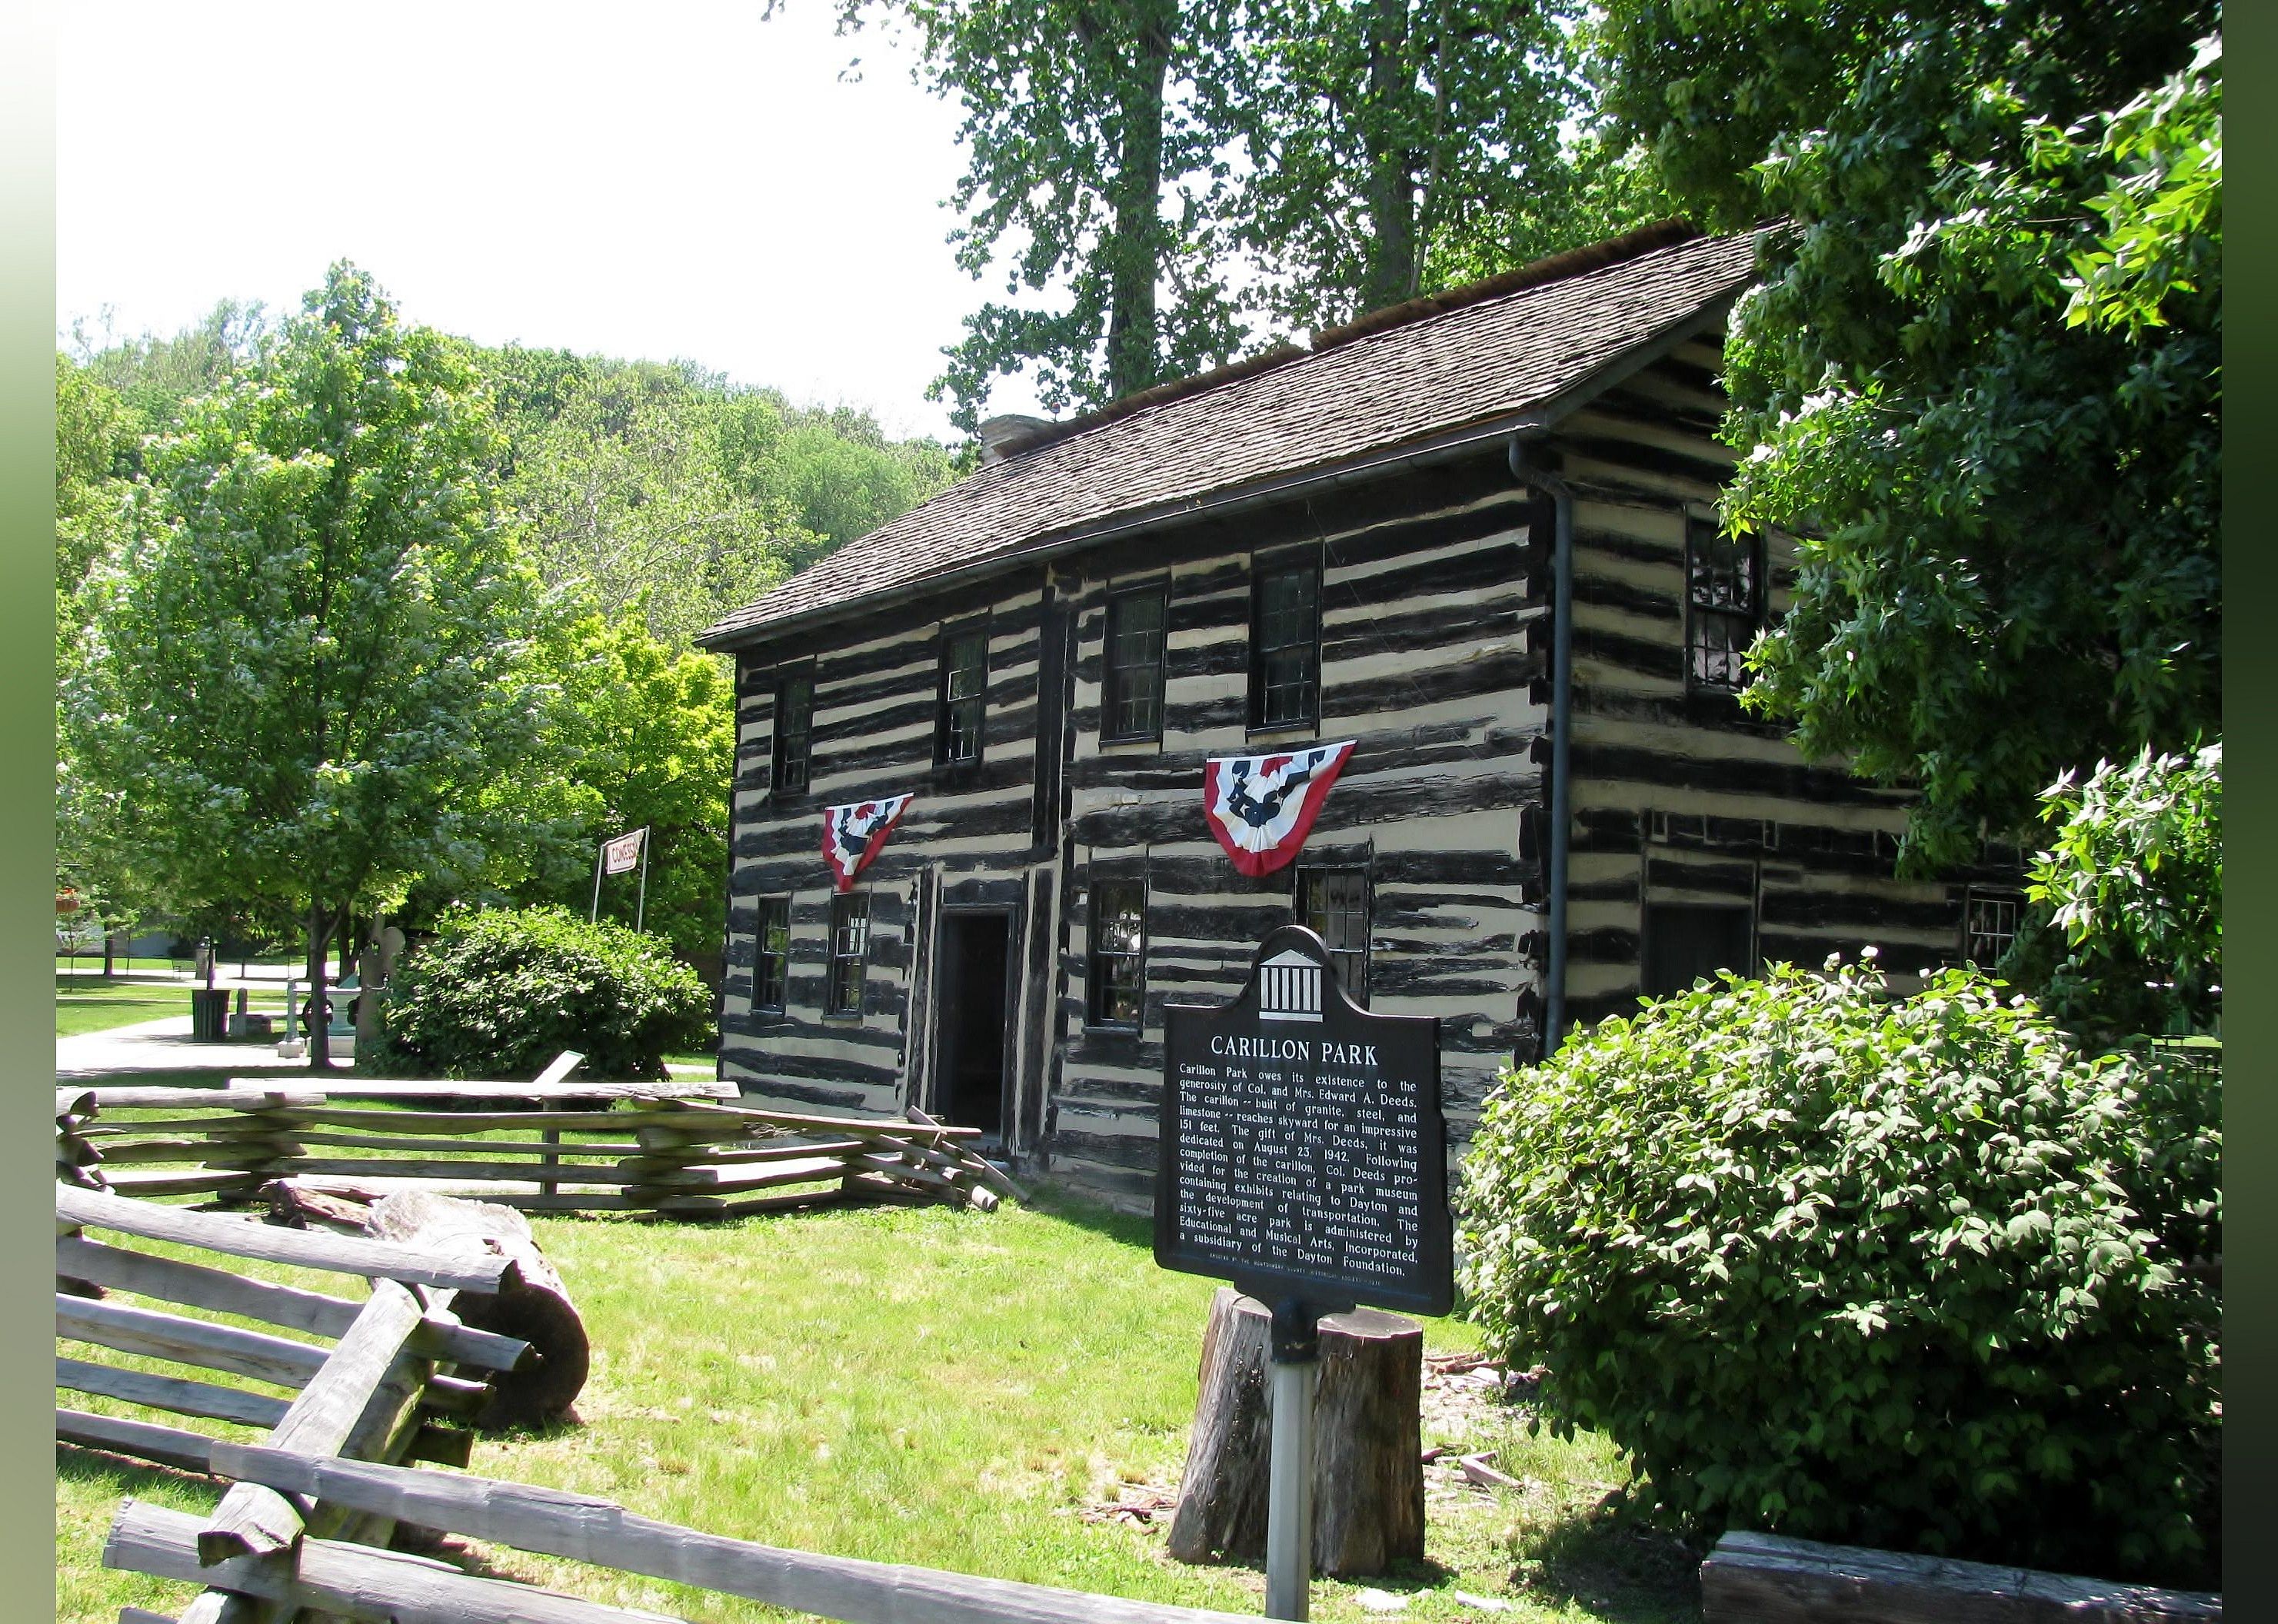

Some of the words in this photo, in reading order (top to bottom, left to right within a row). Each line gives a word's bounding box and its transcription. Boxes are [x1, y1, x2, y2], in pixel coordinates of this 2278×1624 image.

[1211, 1035, 1310, 1061] CARILLON
[1321, 1042, 1378, 1066] PARK
[1179, 1063, 1216, 1077] Carillon
[1226, 1066, 1248, 1079] Park
[1258, 1071, 1282, 1082] owes
[1292, 1071, 1304, 1083] its
[1315, 1073, 1365, 1088] existence
[1377, 1079, 1387, 1090] to
[1400, 1080, 1417, 1092] the
[1179, 1079, 1227, 1093] generosity
[1232, 1081, 1244, 1093] of
[1271, 1086, 1288, 1097] and
[1319, 1088, 1356, 1103] Edward
[1179, 1090, 1197, 1103] The
[1204, 1094, 1239, 1107] carillon
[1255, 1097, 1277, 1110] built
[1285, 1101, 1296, 1112] of
[1397, 1112, 1417, 1124] and
[1179, 1104, 1221, 1119] limestone
[1237, 1112, 1274, 1124] reaches
[1277, 1114, 1318, 1130] skyward
[1324, 1119, 1339, 1131] for
[1344, 1123, 1356, 1133] an
[1361, 1122, 1417, 1139] impressive
[1179, 1133, 1224, 1148] dedicated
[1232, 1141, 1244, 1150] on
[1254, 1141, 1288, 1156] August
[1366, 1153, 1417, 1173] Following
[1180, 1118, 1192, 1130] 151
[1231, 1123, 1250, 1136] The
[1257, 1127, 1276, 1141] gift
[1284, 1130, 1295, 1142] of
[1379, 1139, 1387, 1151] it
[1397, 1144, 1417, 1154] was
[1179, 1160, 1205, 1173] vided
[1212, 1164, 1226, 1176] for
[1234, 1168, 1249, 1179] the
[1256, 1172, 1297, 1186] creation
[1305, 1176, 1317, 1188] of
[1325, 1181, 1331, 1190] a
[1340, 1183, 1365, 1194] park
[1375, 1187, 1418, 1201] museum
[1180, 1148, 1228, 1163] completion
[1236, 1153, 1246, 1165] of
[1253, 1156, 1268, 1167] the
[1353, 1166, 1385, 1181] Deeds
[1394, 1174, 1418, 1186] pro-
[1179, 1176, 1227, 1194] containing
[1234, 1183, 1274, 1197] exhibits
[1282, 1189, 1321, 1206] relating
[1330, 1195, 1340, 1206] to
[1350, 1196, 1387, 1213] Dayton
[1398, 1205, 1418, 1217] and
[1180, 1188, 1195, 1200] the
[1205, 1192, 1264, 1210] development
[1277, 1203, 1289, 1214] of
[1397, 1218, 1418, 1232] The
[1179, 1202, 1226, 1219] sixty-five
[1236, 1213, 1257, 1223] acre
[1269, 1216, 1292, 1229] park
[1304, 1220, 1313, 1231] is
[1324, 1224, 1392, 1243] administered
[1405, 1234, 1418, 1250] by
[1180, 1215, 1232, 1234] Educational
[1240, 1226, 1257, 1238] and
[1265, 1229, 1301, 1245] Musical
[1179, 1232, 1185, 1240] a
[1194, 1233, 1242, 1252] subsidiary
[1251, 1242, 1262, 1253] of
[1272, 1244, 1287, 1257] the
[1297, 1248, 1333, 1265] Dayton
